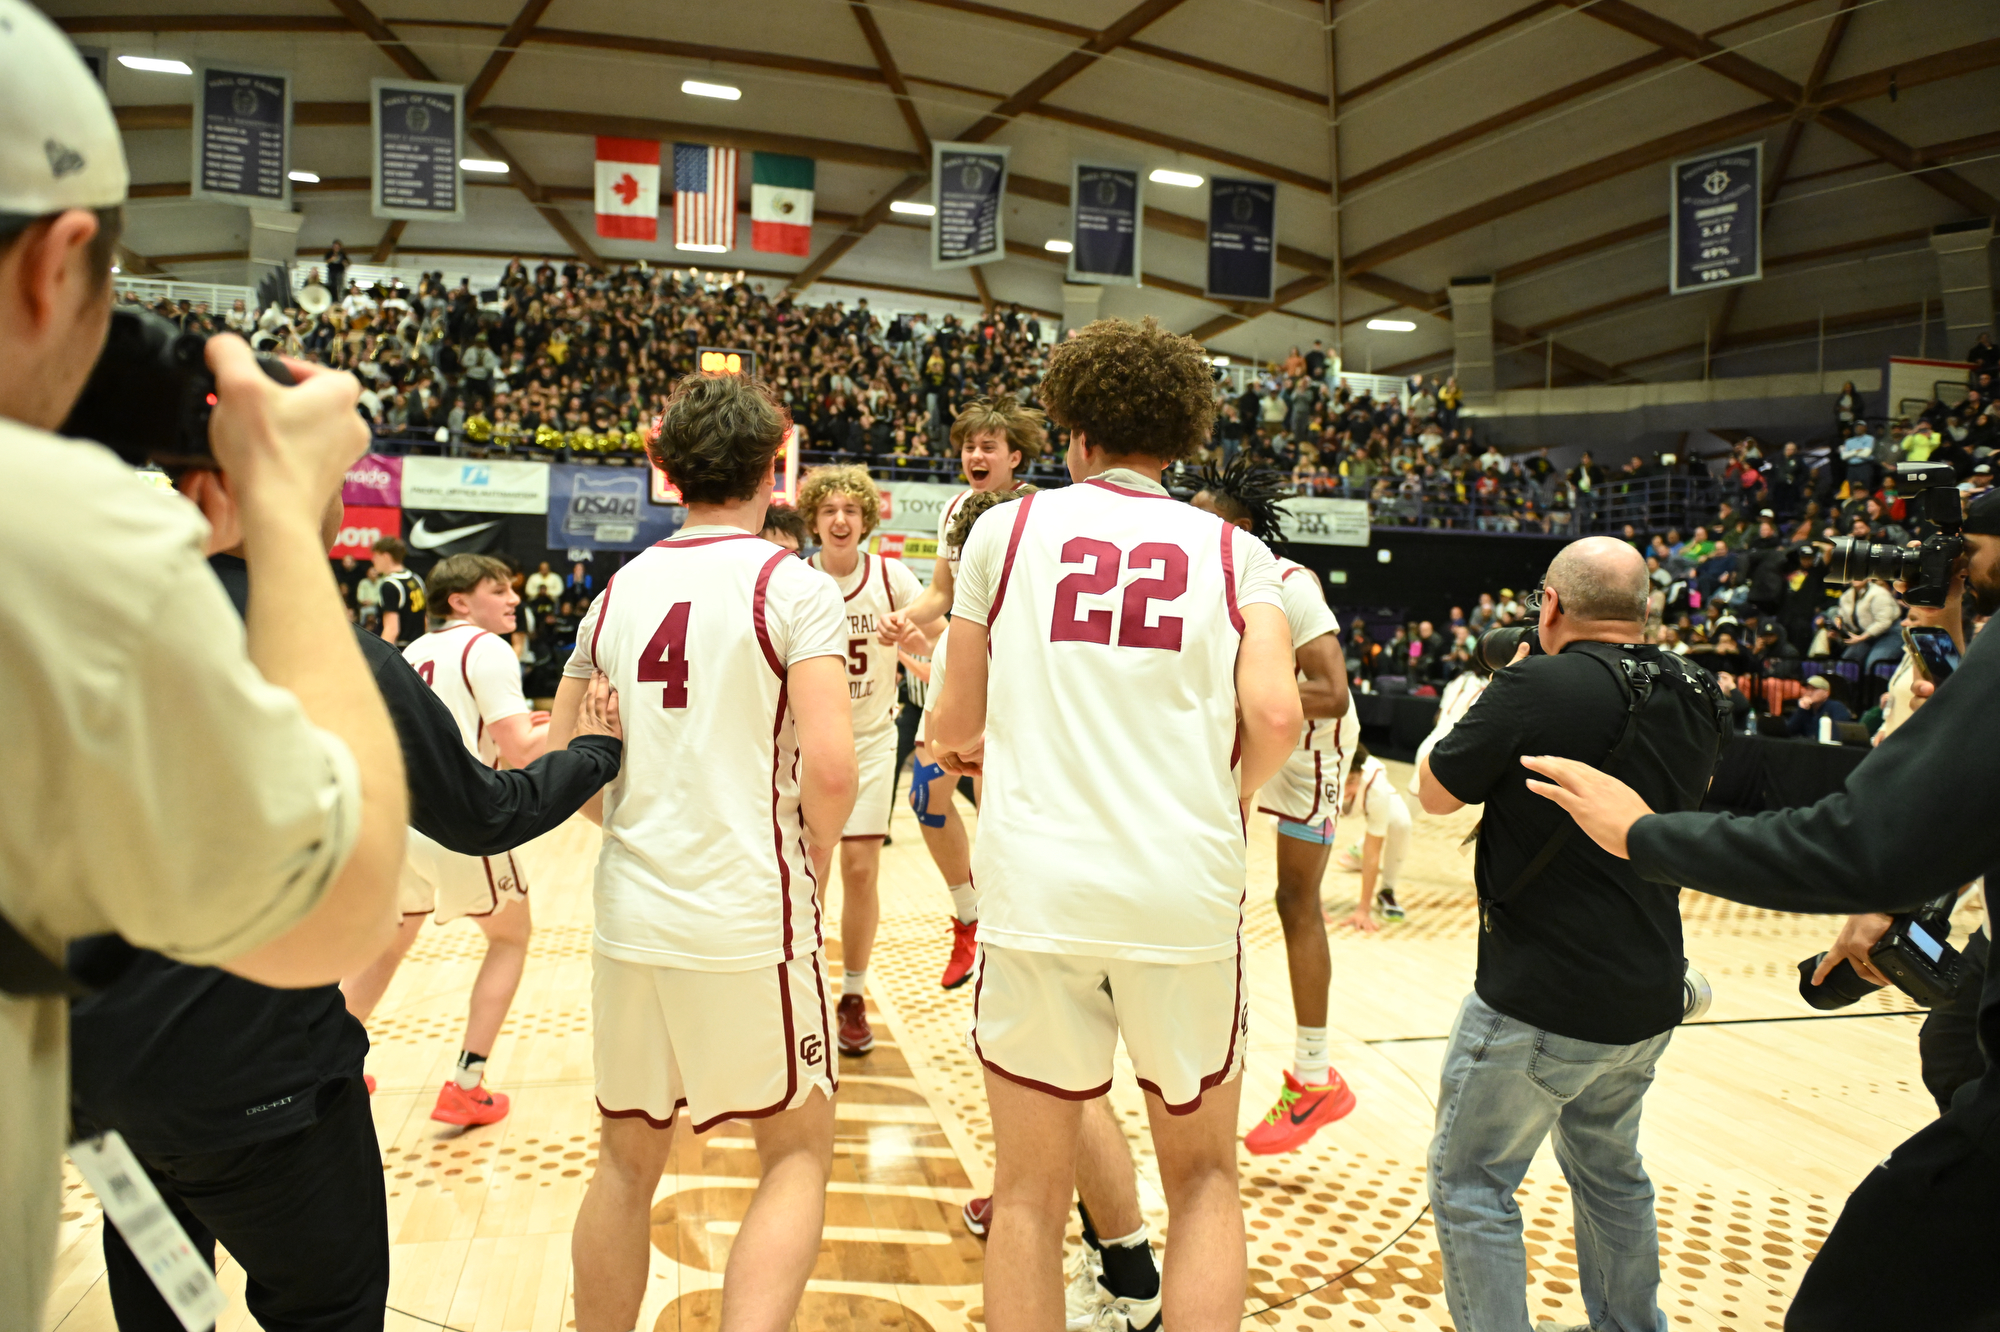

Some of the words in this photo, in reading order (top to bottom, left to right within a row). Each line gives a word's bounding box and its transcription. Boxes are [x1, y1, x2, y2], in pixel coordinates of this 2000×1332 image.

[383, 95, 408, 107] HALL
[409, 94, 423, 103] OF
[426, 97, 452, 113] FAME
[572, 496, 636, 515] OSAA
[1050, 536, 1189, 652] 22
[637, 601, 691, 708] 4
[800, 1033, 823, 1067] CC
[246, 1095, 293, 1116] DRI-FIT
